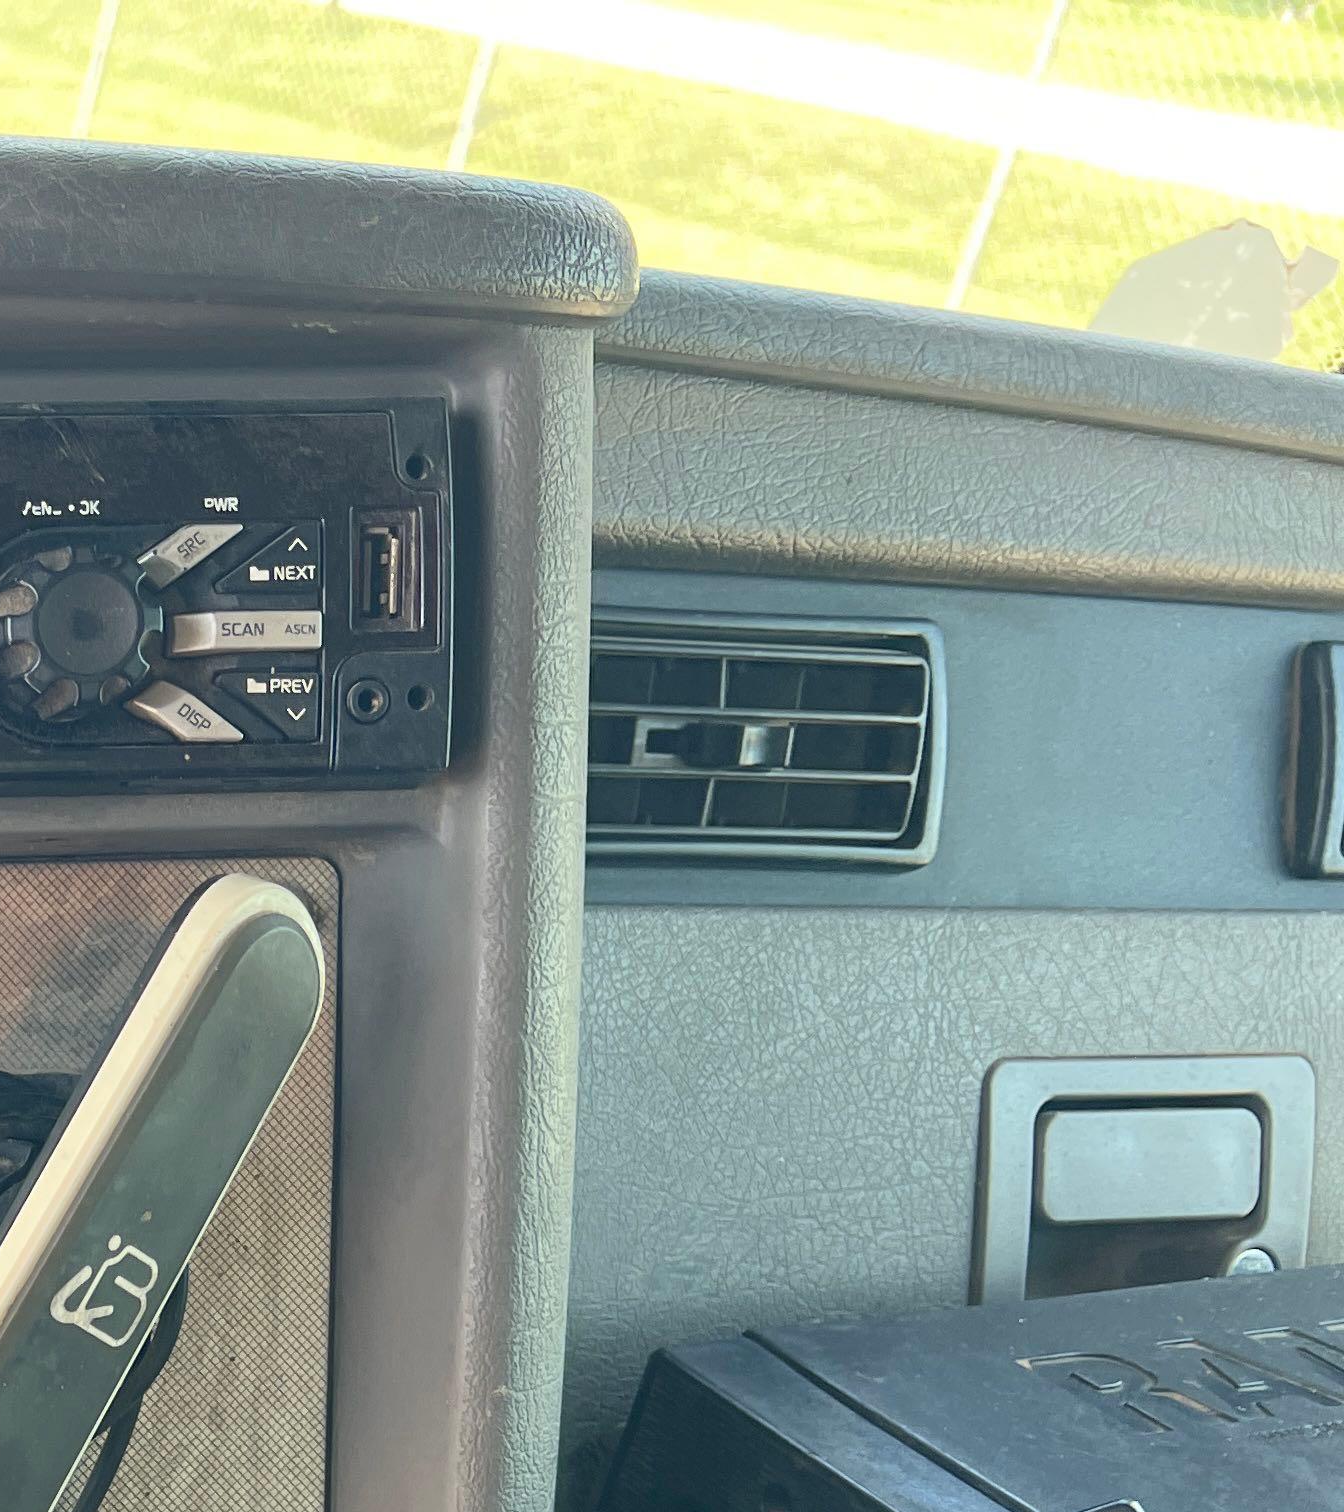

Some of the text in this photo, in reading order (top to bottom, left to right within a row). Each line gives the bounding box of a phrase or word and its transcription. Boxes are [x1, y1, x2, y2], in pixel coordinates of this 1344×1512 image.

[22, 500, 63, 516] EN
[204, 497, 239, 512] PWR
[176, 531, 207, 559] SRC
[272, 564, 317, 581] NEXT
[220, 621, 265, 638] SCAN
[283, 622, 317, 636] ASCN
[268, 677, 314, 694] PREV
[176, 702, 212, 731] DISP
